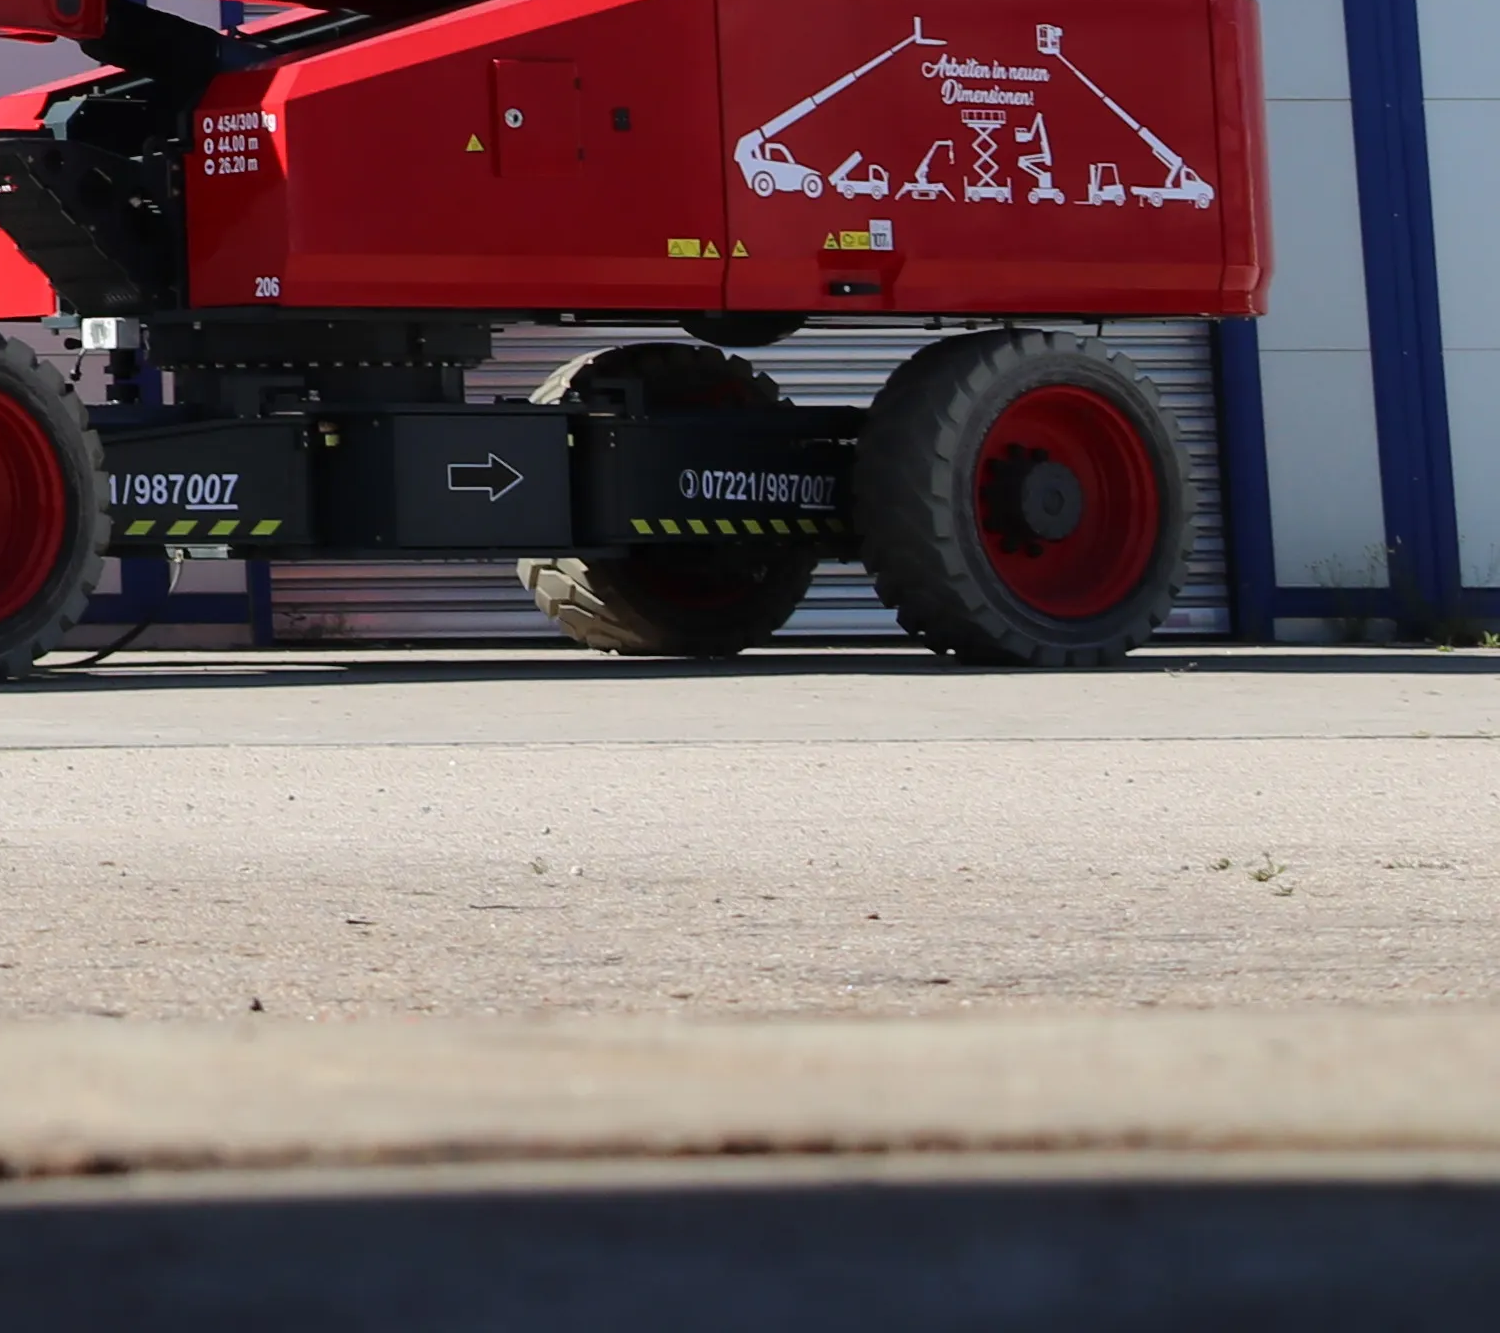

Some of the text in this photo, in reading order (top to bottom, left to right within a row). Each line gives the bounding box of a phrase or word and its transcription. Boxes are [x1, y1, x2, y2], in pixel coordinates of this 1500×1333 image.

[921, 53, 1051, 82] Arbeiten in neuen
[941, 79, 1035, 106] Dimensionen!
[217, 110, 277, 133] 454/300 kg
[217, 134, 259, 153] 44.00 m
[218, 155, 258, 175] 26.20 m
[255, 276, 280, 297] 206
[702, 469, 836, 504] 07221/987007
